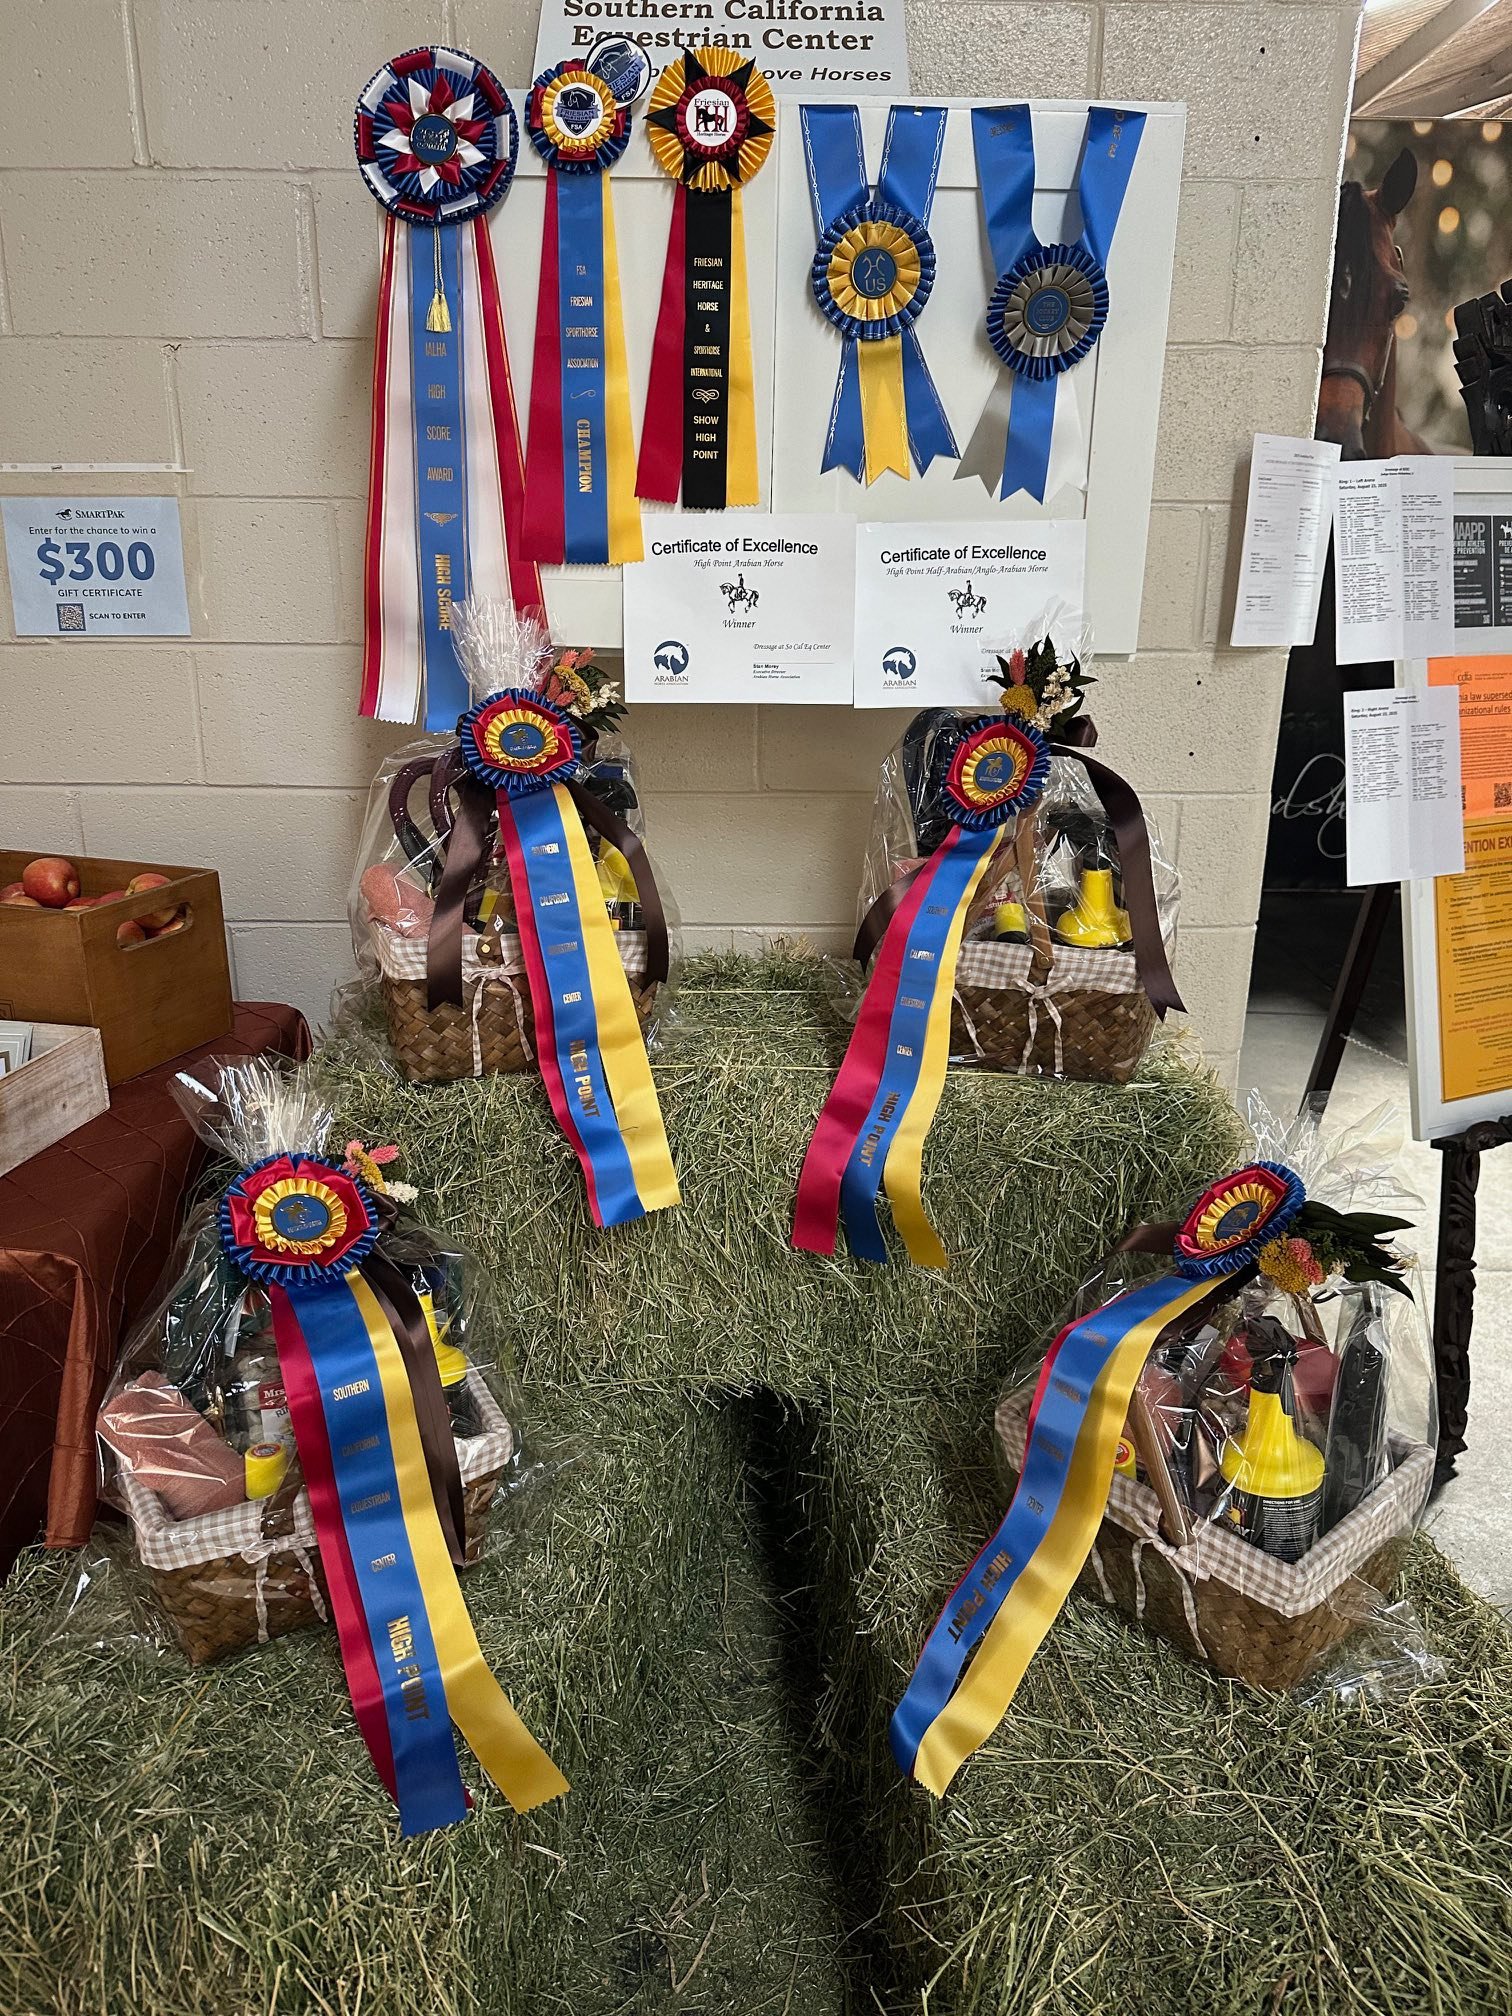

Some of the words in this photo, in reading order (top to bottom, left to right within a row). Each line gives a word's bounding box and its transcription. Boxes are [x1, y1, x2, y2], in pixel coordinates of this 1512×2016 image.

[564, 0, 714, 19] Southern
[724, 0, 885, 21] California
[762, 27, 874, 50] Center
[763, 67, 802, 81] ove
[811, 67, 892, 81] Horses
[694, 98, 729, 106] Friesian
[570, 123, 583, 131] FSA
[693, 257, 723, 268] FRIESIAN
[576, 265, 587, 276] FSA
[693, 280, 724, 290] HERITAGE
[865, 278, 887, 292] US
[697, 301, 719, 312] HORSE
[565, 327, 598, 338] SPORTHORSE
[704, 323, 711, 333] &
[567, 358, 599, 369] ASSOCIATION
[690, 367, 723, 378] INTERNATIONAL
[428, 384, 446, 399] HIGH
[693, 415, 720, 425] SHOW
[426, 426, 452, 441] SCORE
[695, 433, 717, 442] HIGH
[576, 418, 593, 493] CHAMPION
[693, 450, 719, 460] POINT
[427, 467, 453, 481] AWARD
[29, 527, 52, 535] Enter
[55, 527, 67, 535] for
[70, 527, 84, 535] the
[86, 527, 118, 535] chance
[132, 527, 148, 535] win
[651, 540, 722, 555] Certificate
[725, 538, 740, 552] of
[742, 538, 818, 555] Excellence
[880, 547, 950, 564] Certificate
[954, 546, 968, 559] of
[971, 545, 1047, 561] Excellence
[37, 537, 155, 586] $300
[693, 559, 712, 569] High
[713, 559, 732, 567] Point
[733, 559, 762, 568] Arabian
[763, 559, 784, 567] Horse
[434, 553, 452, 585] HIGH
[886, 567, 904, 577] High
[905, 567, 924, 575] Point
[57, 589, 79, 597] GIFT
[82, 589, 143, 597] CERTIFICATE
[722, 619, 756, 629] Winner
[950, 624, 984, 634] Winner
[1469, 691, 1482, 700] law
[1494, 704, 1511, 713] rules
[539, 892, 570, 907] CALIFORNIA
[909, 949, 935, 961] CALIFORNIA
[569, 1040, 589, 1073] HIGH
[896, 1045, 913, 1057] CENTER
[575, 1074, 600, 1118] POINT
[878, 1091, 900, 1123] HIGH
[859, 1124, 886, 1168] POINT
[333, 1379, 370, 1401] SOUTHERN
[370, 1552, 397, 1573] CENTER
[980, 1550, 1013, 1593] HIGH
[947, 1588, 985, 1645] POINT
[386, 1615, 416, 1663] HIGH
[397, 1663, 432, 1722] POINT
